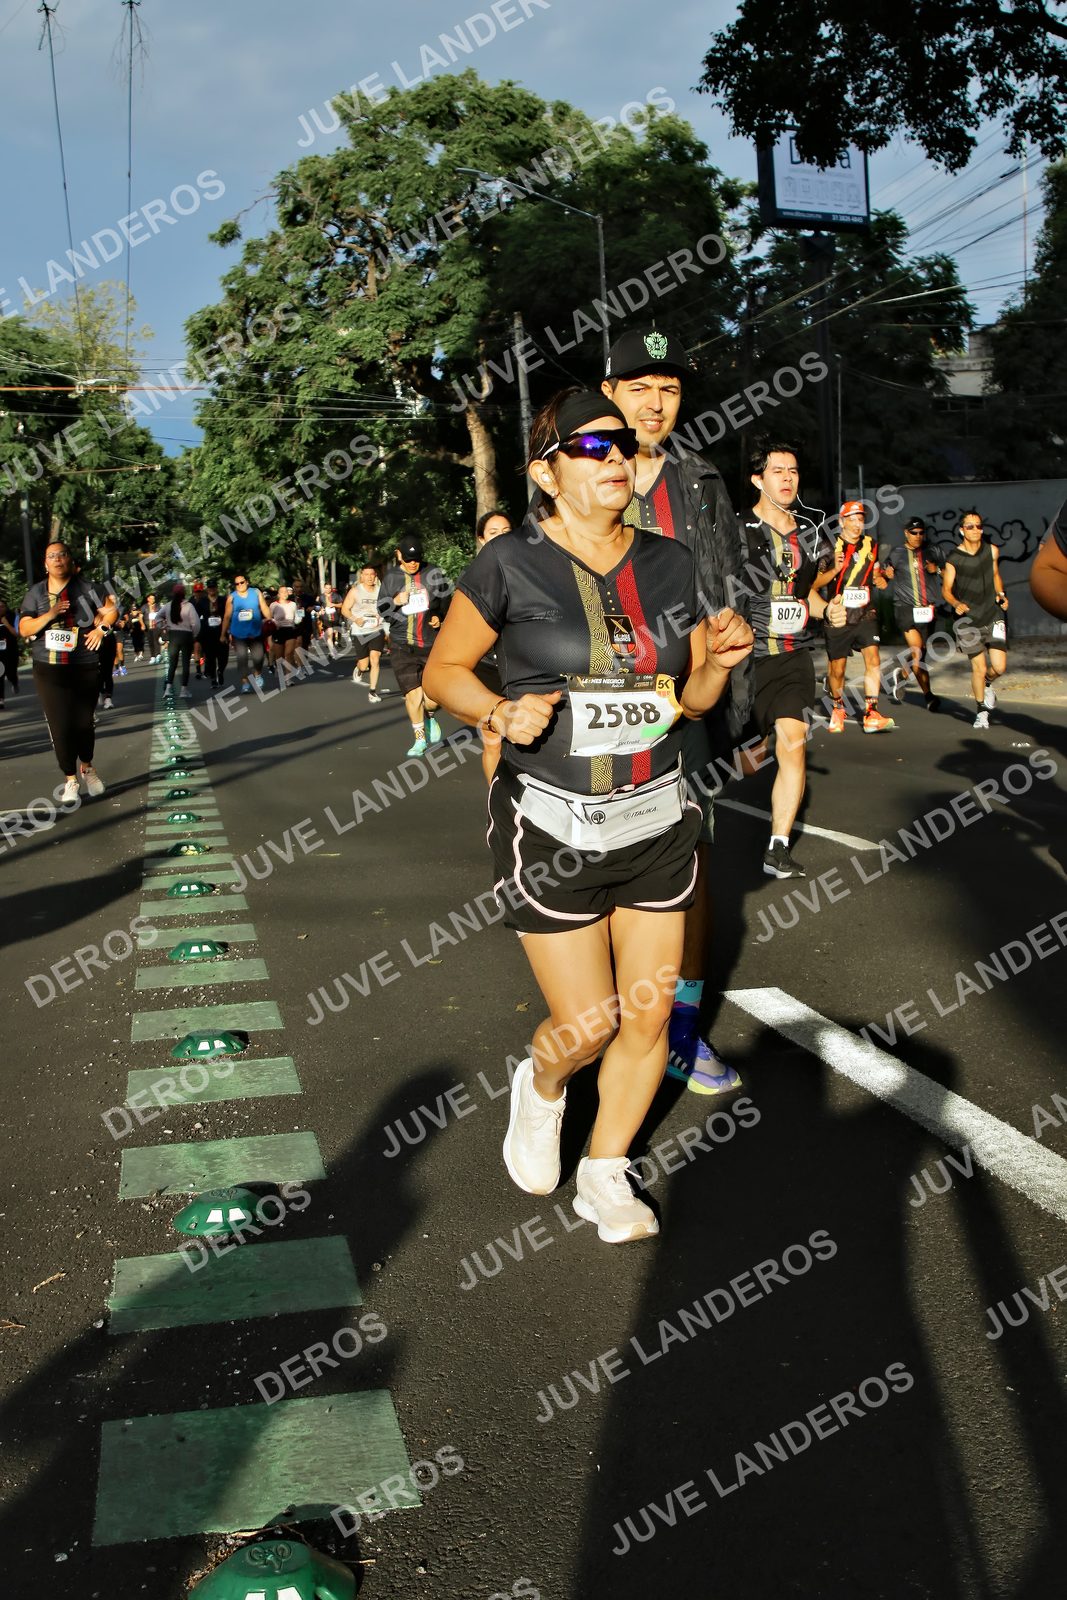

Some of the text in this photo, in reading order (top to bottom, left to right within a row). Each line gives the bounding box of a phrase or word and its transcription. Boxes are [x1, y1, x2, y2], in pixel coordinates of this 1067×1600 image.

[926, 506, 976, 523] TO
[777, 607, 802, 620] 8074
[658, 679, 670, 689] 5K
[584, 702, 661, 730] 2588
